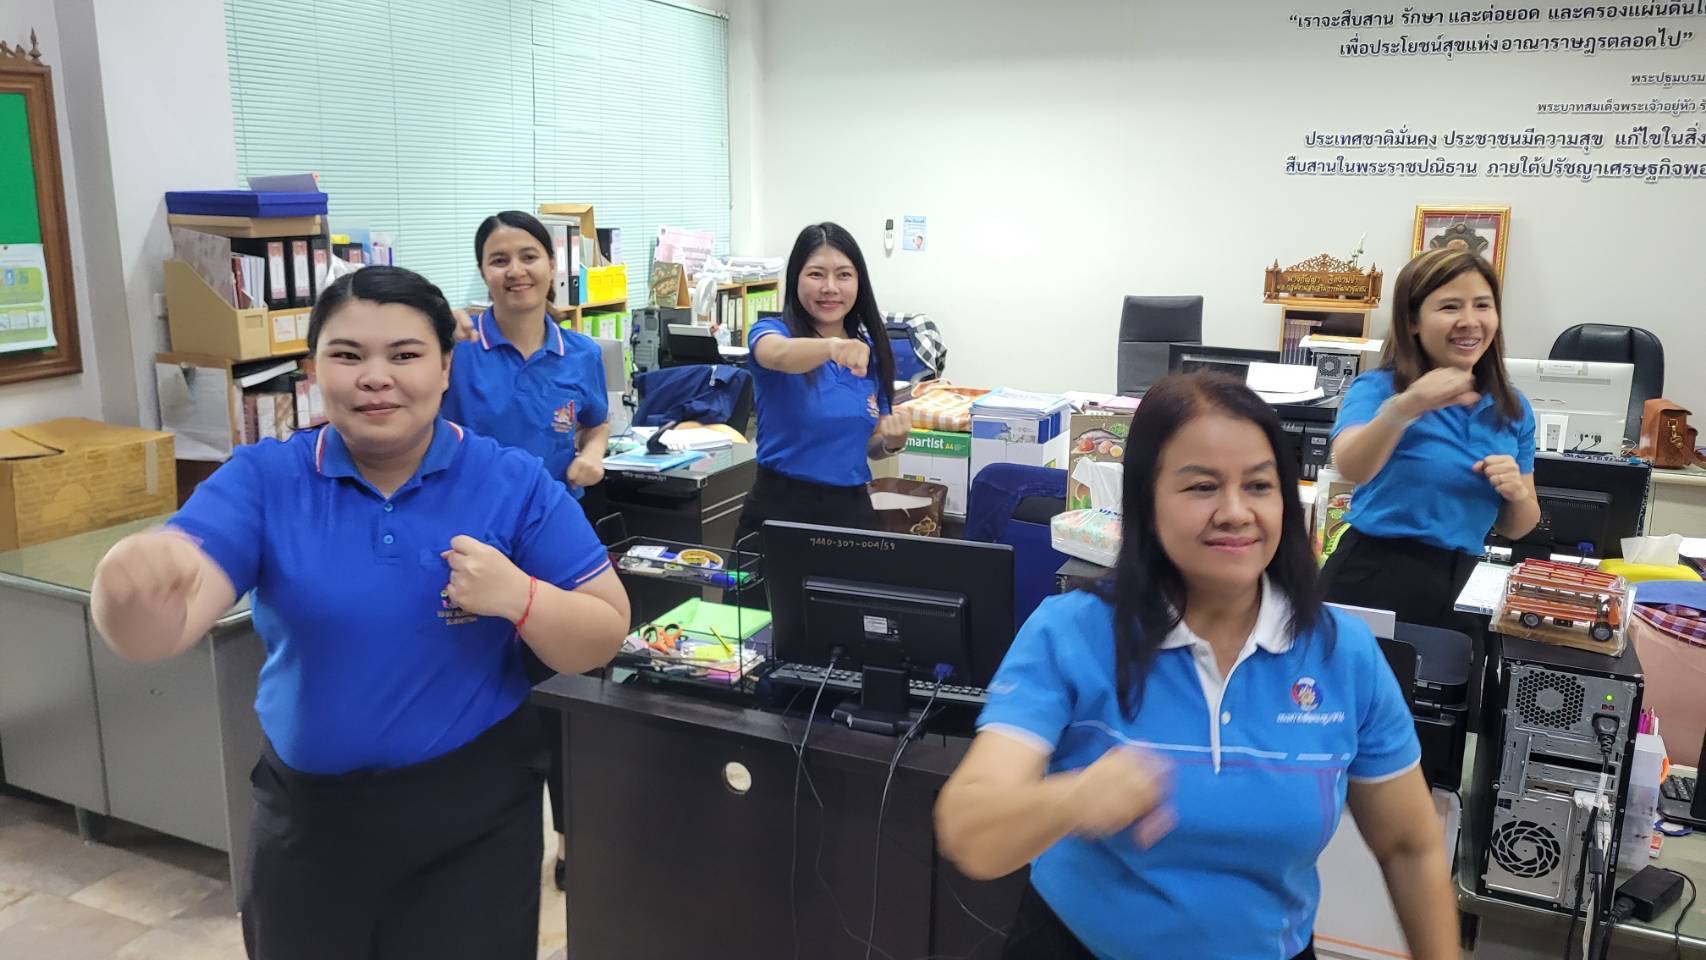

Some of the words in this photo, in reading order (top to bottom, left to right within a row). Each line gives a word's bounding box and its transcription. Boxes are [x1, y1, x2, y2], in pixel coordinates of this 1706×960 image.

[1401, 6, 1444, 24] รักษา
[1443, 128, 1603, 151] ประชาชนมีความสุข
[1285, 155, 1477, 174] สืบสานในพระราชปณิธาน
[906, 437, 944, 449] martist
